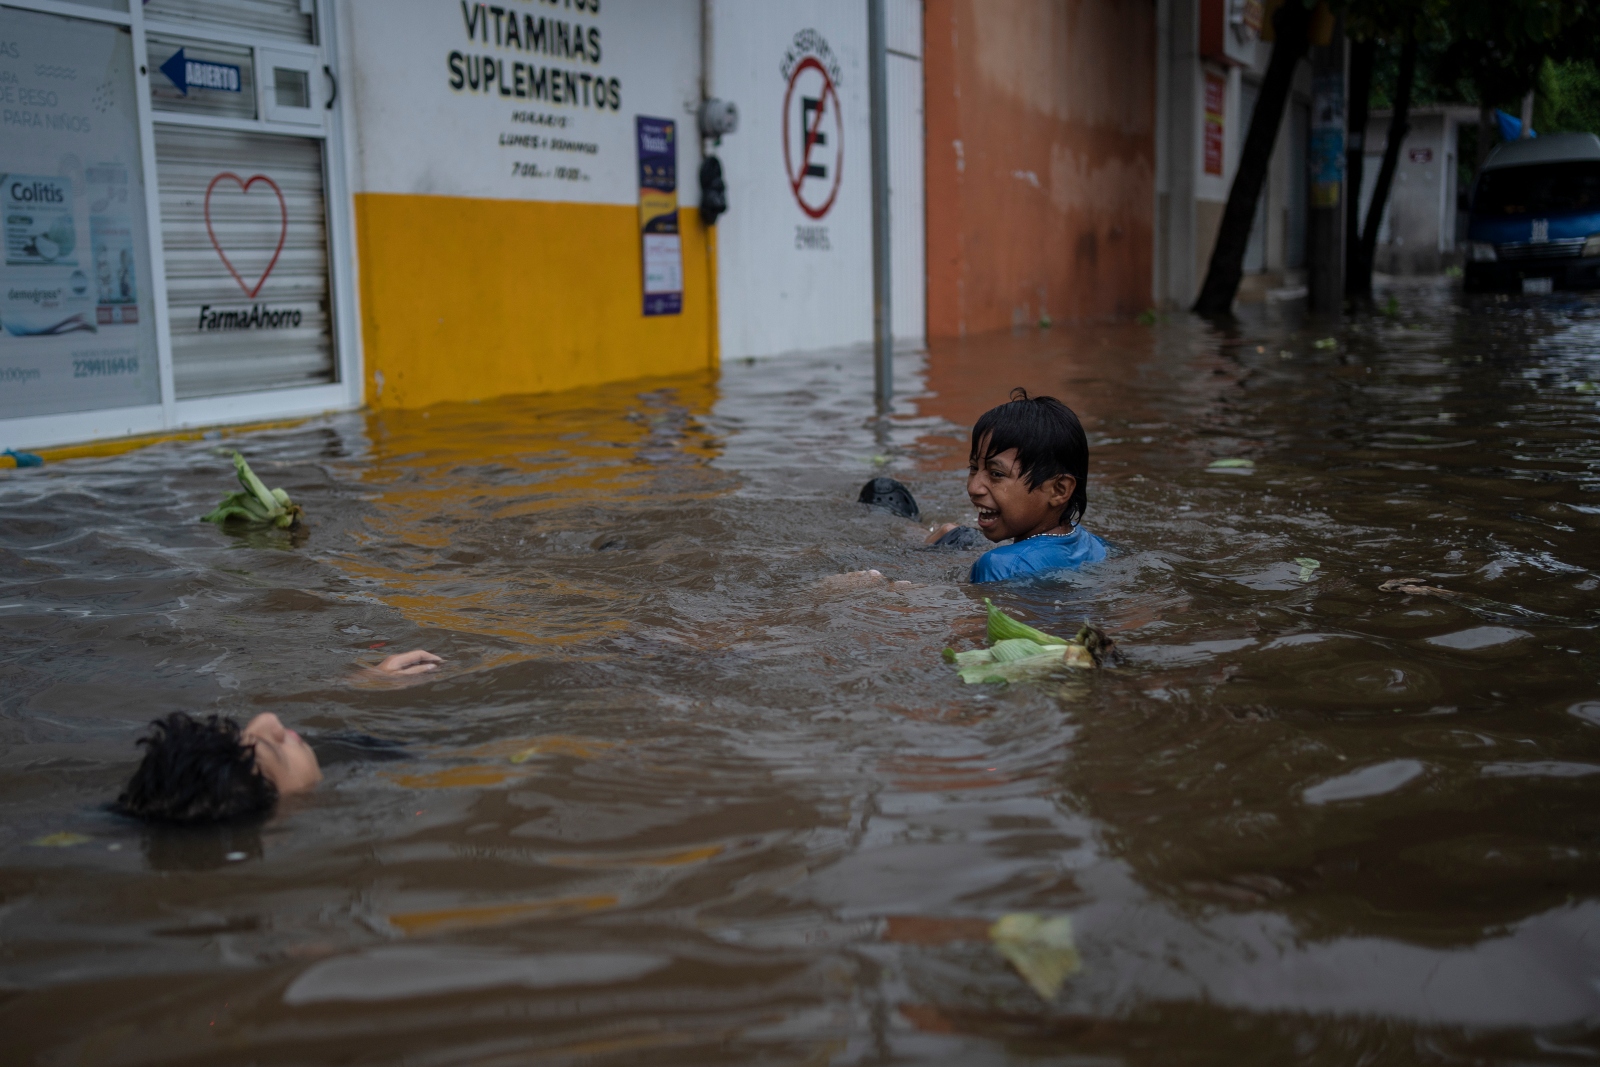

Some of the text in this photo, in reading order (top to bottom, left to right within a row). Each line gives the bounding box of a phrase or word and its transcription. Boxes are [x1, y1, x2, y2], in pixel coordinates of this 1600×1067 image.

[460, 0, 602, 64] VITAMINAS
[0, 70, 19, 84] RA
[185, 61, 239, 91] ABIERTO
[448, 50, 622, 110] SUPLEMENTOS
[18, 87, 58, 107] PESO
[3, 109, 91, 133] PARA NIÑOS
[498, 132, 539, 149] LUNES
[550, 139, 599, 155] DOMINGO
[802, 97, 827, 178] E
[10, 182, 64, 203] Colitis
[198, 303, 303, 330] FarmaAhorro
